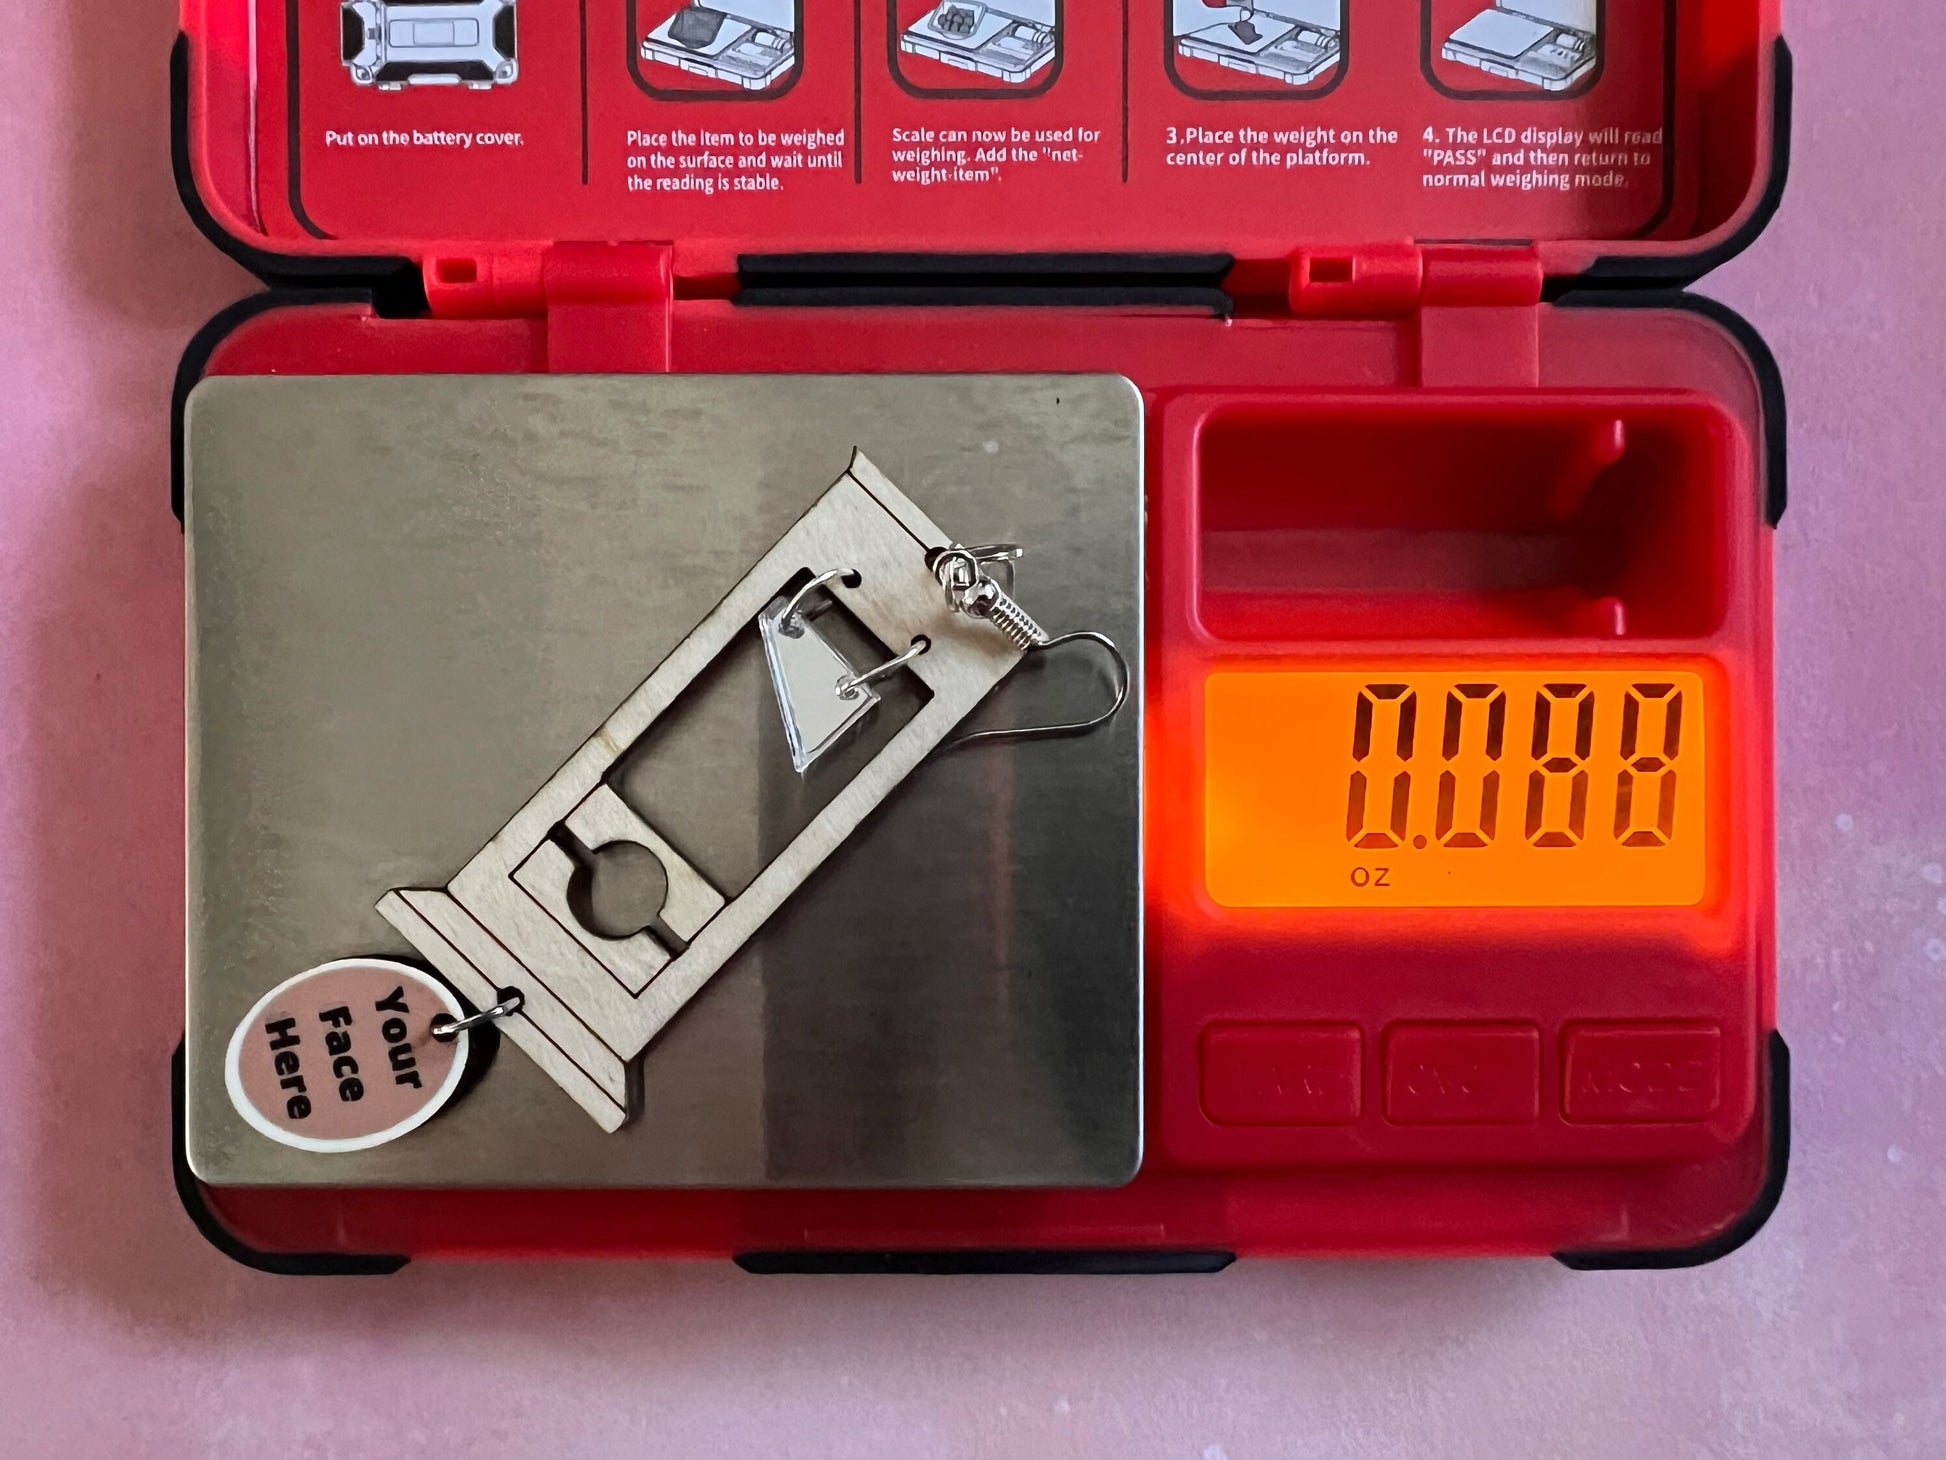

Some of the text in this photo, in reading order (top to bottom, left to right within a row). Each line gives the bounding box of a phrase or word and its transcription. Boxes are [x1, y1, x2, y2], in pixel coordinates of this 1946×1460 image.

[326, 130, 524, 149] Put on the battery cover.
[627, 130, 667, 146] Place
[672, 129, 696, 146] the
[739, 131, 754, 146] to
[758, 129, 776, 146] be
[781, 128, 844, 149] weighed
[892, 127, 1100, 143] Scale can now be used for
[1239, 127, 1268, 144] the
[1273, 126, 1336, 147] weight
[1340, 130, 1363, 144] on
[1369, 126, 1398, 144] the
[1423, 126, 1663, 149] 4. The LCD display will read
[627, 151, 842, 168] on the surface and wait until
[892, 147, 971, 166] weighing.
[975, 147, 1006, 162] Add
[1011, 147, 1038, 162] the
[1166, 148, 1371, 169] center of the platform.
[1423, 149, 1650, 167] "PASS" and then return to
[627, 173, 784, 195] the reading is stable.
[1423, 169, 1628, 191] normal weighing mode.
[1346, 683, 1683, 850] 0.088
[375, 986, 422, 1089] Your
[319, 1006, 364, 1102] Face
[265, 1017, 312, 1120] Here
